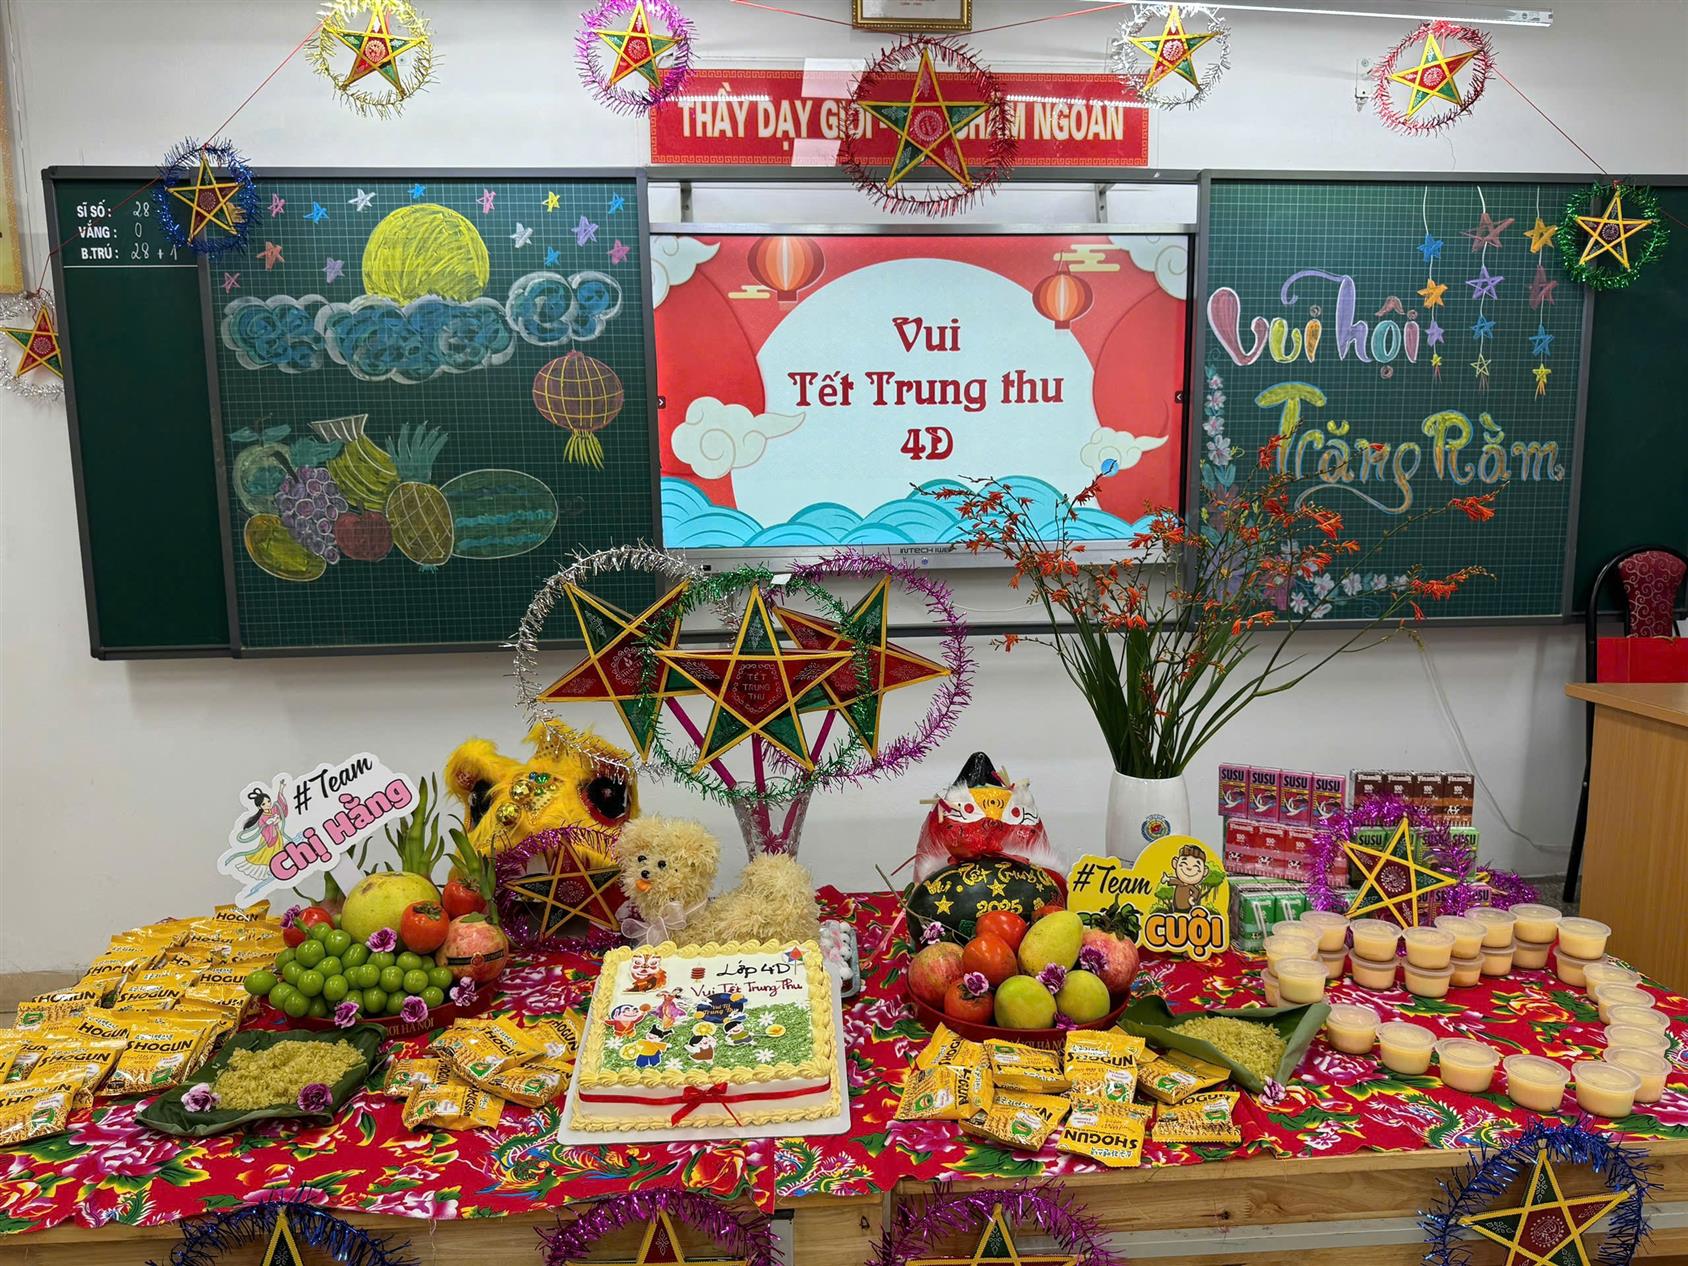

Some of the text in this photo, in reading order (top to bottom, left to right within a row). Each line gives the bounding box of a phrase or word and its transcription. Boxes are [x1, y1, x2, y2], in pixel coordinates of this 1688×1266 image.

[678, 82, 749, 138] THẦY
[757, 100, 813, 150] DẠY
[1034, 100, 1124, 141] NGOAN
[76, 201, 88, 218] SĨ
[132, 201, 150, 218] 28
[134, 222, 143, 238] 0
[131, 242, 150, 260] 28
[892, 316, 961, 353] Vui
[1207, 269, 1420, 379] Vui hội
[787, 369, 1064, 413] Tết Trung thu
[899, 426, 954, 462] 4D
[1254, 381, 1565, 515] Trăng Rằm
[293, 757, 373, 816] #Team
[1221, 768, 1340, 792] SUSU SUSU SUSU SUSU
[322, 778, 413, 846] Hằng
[1359, 834, 1383, 845] SUSU
[1072, 863, 1153, 896] #Team
[976, 898, 1023, 918] 2025
[1144, 907, 1224, 956] CUỘI
[716, 959, 758, 979] Lớp
[690, 984, 716, 998] Vui
[78, 1021, 130, 1039] HOGUN
[124, 1040, 194, 1052] SHOGUN
[938, 1037, 964, 1066] SHOG
[39, 1053, 111, 1067] SHOGUN
[1064, 1130, 1139, 1150] SHOGUN
